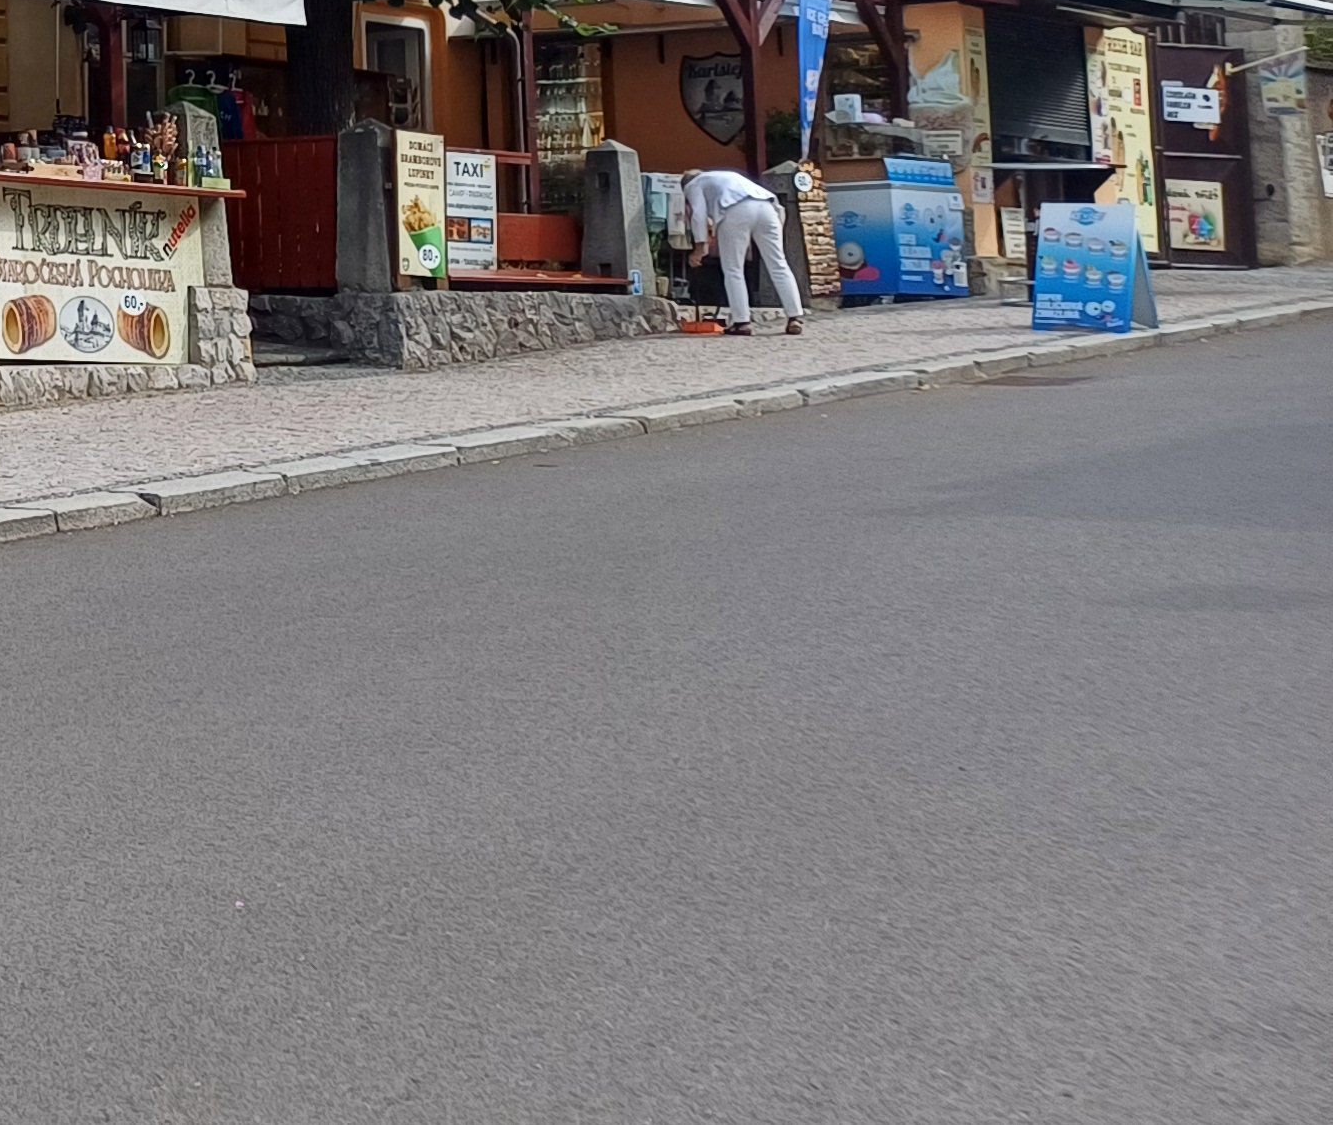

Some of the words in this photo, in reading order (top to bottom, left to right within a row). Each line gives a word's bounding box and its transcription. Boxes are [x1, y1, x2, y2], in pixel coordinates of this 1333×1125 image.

[453, 161, 484, 178] TAXI
[162, 203, 197, 259] nutella
[123, 295, 144, 312] 60,-
